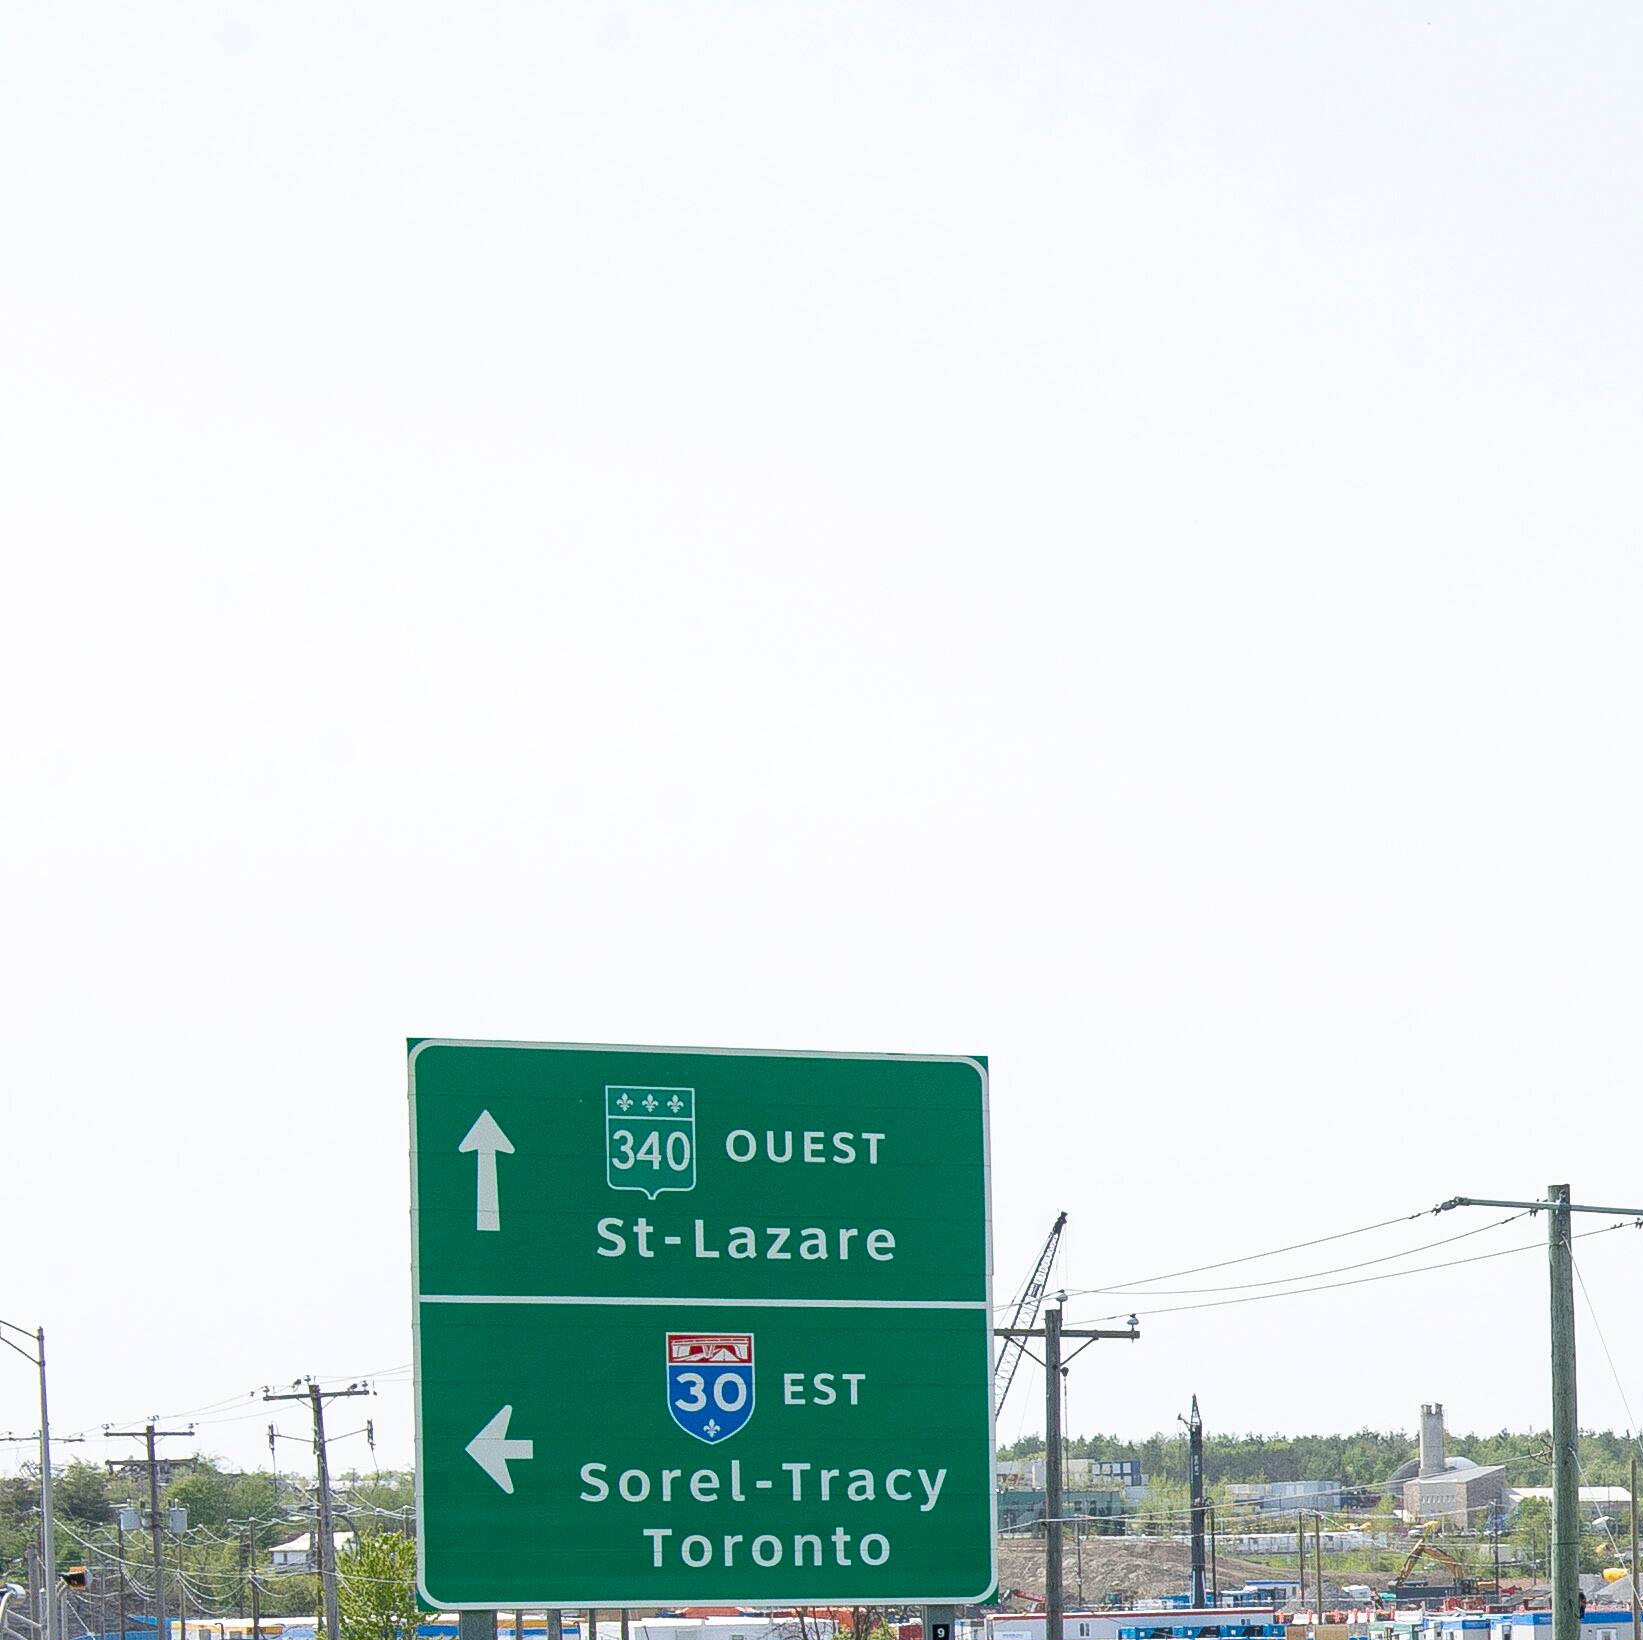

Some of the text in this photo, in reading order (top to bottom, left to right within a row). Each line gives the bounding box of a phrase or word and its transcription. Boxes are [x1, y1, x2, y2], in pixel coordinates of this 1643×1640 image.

[612, 1129, 885, 1171] 340 OUEST
[597, 1217, 896, 1261] St-Lazare
[675, 1372, 866, 1412] 30 EST
[580, 1459, 947, 1512] Sorel-Tracy
[643, 1527, 890, 1568] Toronto
